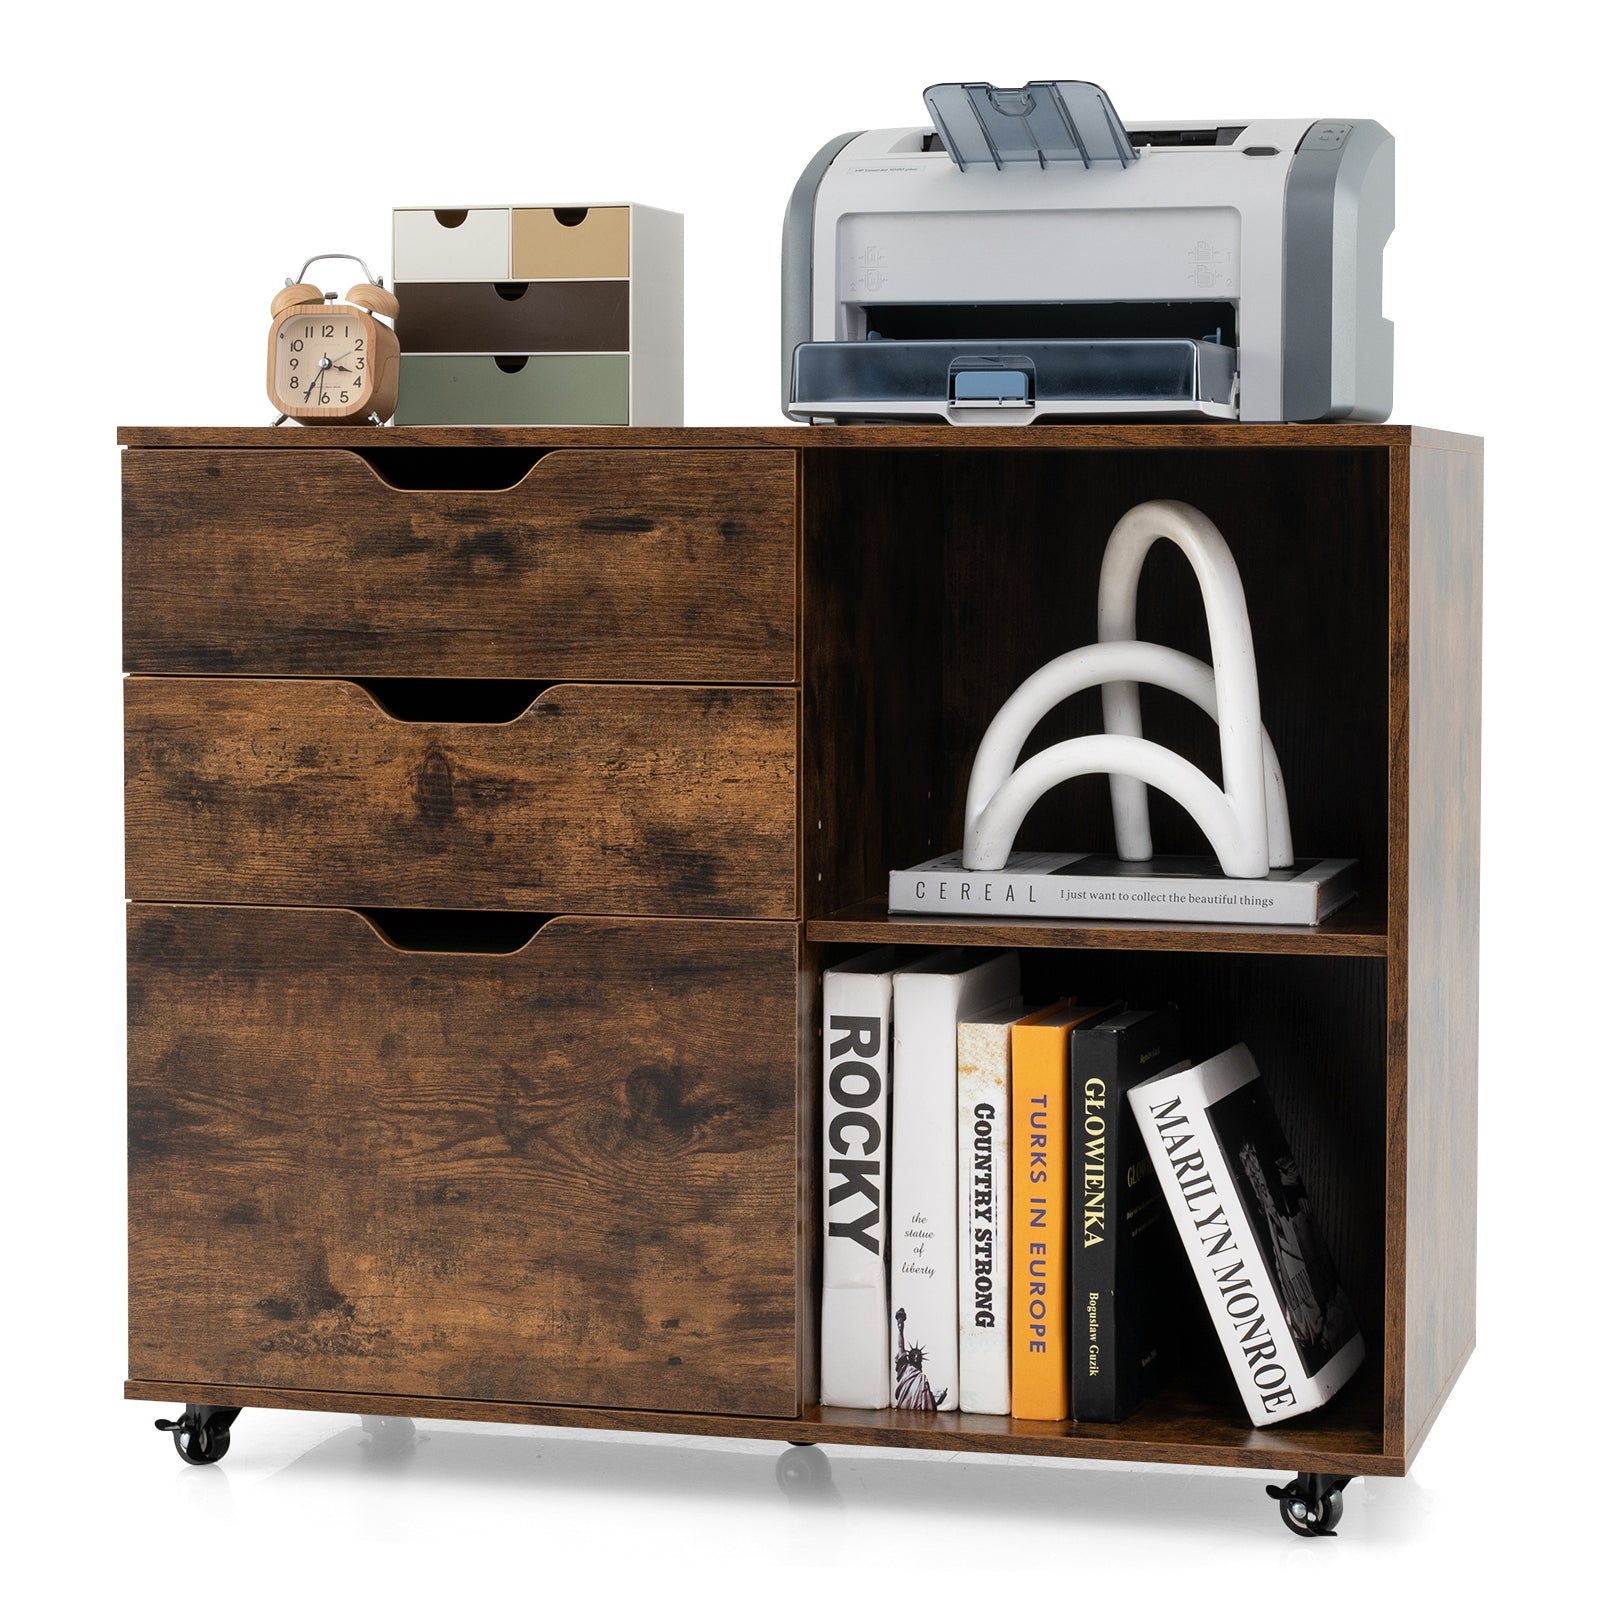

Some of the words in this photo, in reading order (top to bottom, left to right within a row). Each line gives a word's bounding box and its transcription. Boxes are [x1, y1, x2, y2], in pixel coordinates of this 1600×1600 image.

[306, 326, 313, 338] 11
[322, 325, 334, 337] 12
[290, 339, 304, 353] 10
[355, 339, 363, 351] 2
[290, 359, 298, 370] 9
[356, 358, 364, 369] 3
[290, 376, 298, 389] 8
[353, 376, 361, 387] 4
[321, 391, 331, 405] 6
[340, 391, 348, 403] 5
[1065, 889, 1087, 902] just
[1132, 892, 1165, 902] collect
[1169, 893, 1185, 903] the
[1189, 894, 1236, 904] beautiful
[1239, 895, 1274, 906] things
[828, 1014, 881, 1256] ROCKY
[1030, 1095, 1047, 1184] TURKS
[973, 1102, 996, 1223] COUNTRY
[1084, 1077, 1106, 1249] GŁOWIENKA
[911, 1211, 928, 1225] the
[1031, 1198, 1046, 1227] IN
[903, 1229, 935, 1239] statue
[913, 1243, 925, 1258] of
[1149, 1095, 1238, 1257] MARILYN
[1212, 1259, 1297, 1414] MONROE
[901, 1261, 936, 1279] liberty
[973, 1229, 996, 1330] STRONG
[1030, 1243, 1046, 1352] EUROPE
[1088, 1344, 1100, 1376] Guzik
